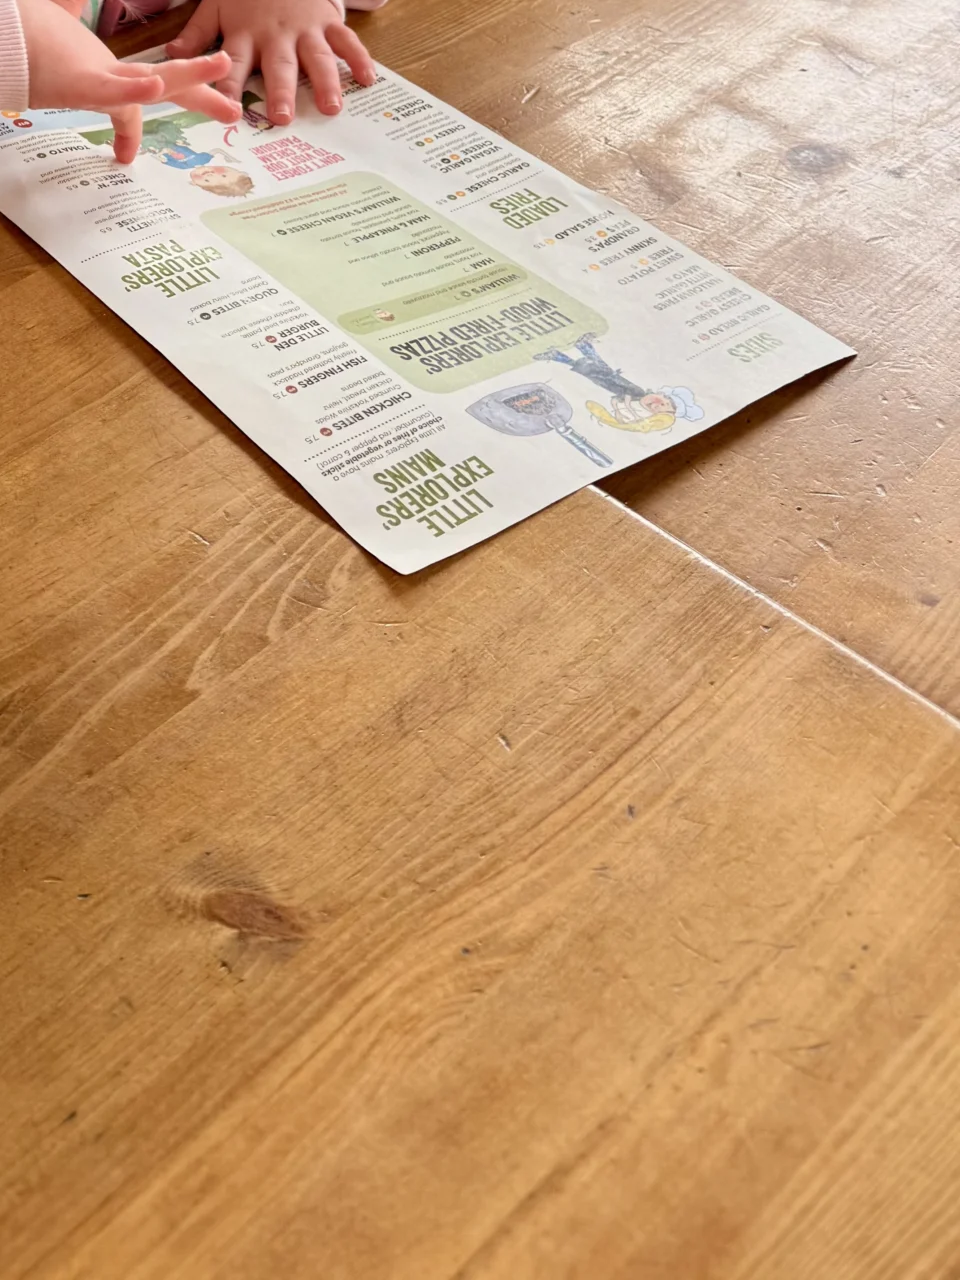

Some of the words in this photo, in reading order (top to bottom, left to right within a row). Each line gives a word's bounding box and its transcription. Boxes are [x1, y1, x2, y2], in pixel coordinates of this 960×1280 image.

[390, 98, 425, 113] CHEESE
[399, 103, 433, 118] BACON
[431, 124, 466, 139] CHEESY
[46, 144, 90, 154] TOMATO
[256, 146, 297, 163] CREAM
[290, 141, 314, 152] ICE
[310, 147, 332, 157] TO
[459, 140, 494, 155] CHEESE
[469, 145, 502, 159] VEGAN
[262, 160, 289, 172] OUR
[284, 151, 316, 165] VISIT
[437, 157, 473, 173] GARLIC
[89, 172, 126, 182] CHEESE
[269, 163, 314, 180] FORGET
[495, 161, 531, 178] GARLIC
[463, 175, 499, 193] CHEESE
[486, 187, 542, 214] FRIES
[320, 210, 355, 223] VEGAN
[405, 214, 431, 225] HAM
[500, 196, 568, 229] LOADED
[285, 219, 323, 233] CHEESE
[349, 224, 400, 243] PINEAPPLE
[552, 222, 586, 239] SALAD
[604, 219, 631, 232] PEAS
[120, 239, 186, 268] PASTA
[408, 236, 462, 256] PEPPERONI
[620, 236, 658, 255] SKINNY
[646, 246, 674, 260] FRIES
[468, 257, 496, 269] HAM
[597, 252, 625, 265] FRIES
[651, 252, 684, 269] SWEET
[152, 266, 220, 297] LITTLE
[615, 266, 655, 285] POTATO
[210, 300, 242, 315] BITES
[446, 295, 557, 341] WOOD-FIRED
[509, 310, 575, 341] LITTLE
[276, 319, 319, 337] BURGER
[295, 326, 329, 342] LITTLE
[272, 337, 298, 351] DEN
[387, 330, 457, 361] PIZZAS
[724, 331, 784, 364] SIDES
[301, 357, 334, 373] battered
[340, 355, 368, 369] FISH
[264, 367, 286, 379] peas
[270, 370, 304, 386] haddock
[296, 365, 344, 388] FINGERS
[361, 370, 386, 383] baked
[339, 379, 364, 392] beans
[365, 377, 394, 391] chicken
[367, 383, 402, 401] Crumbed
[320, 398, 343, 410] Heinz
[335, 398, 369, 415] Yorkshire
[360, 390, 413, 416] CHICKEN
[313, 412, 338, 424] Wolds
[330, 412, 364, 430] BITES
[416, 415, 445, 431] choice
[376, 429, 394, 440] red
[391, 431, 413, 444] fries
[407, 427, 421, 436] of
[417, 428, 438, 439] Little
[348, 436, 381, 454] pepper
[313, 452, 345, 470] carrot)
[343, 444, 386, 467] vegetable
[358, 453, 385, 468] mains
[319, 462, 348, 478] sticks
[337, 464, 361, 478] have
[368, 448, 447, 494] MAINS
[415, 488, 494, 537] LITTLE
